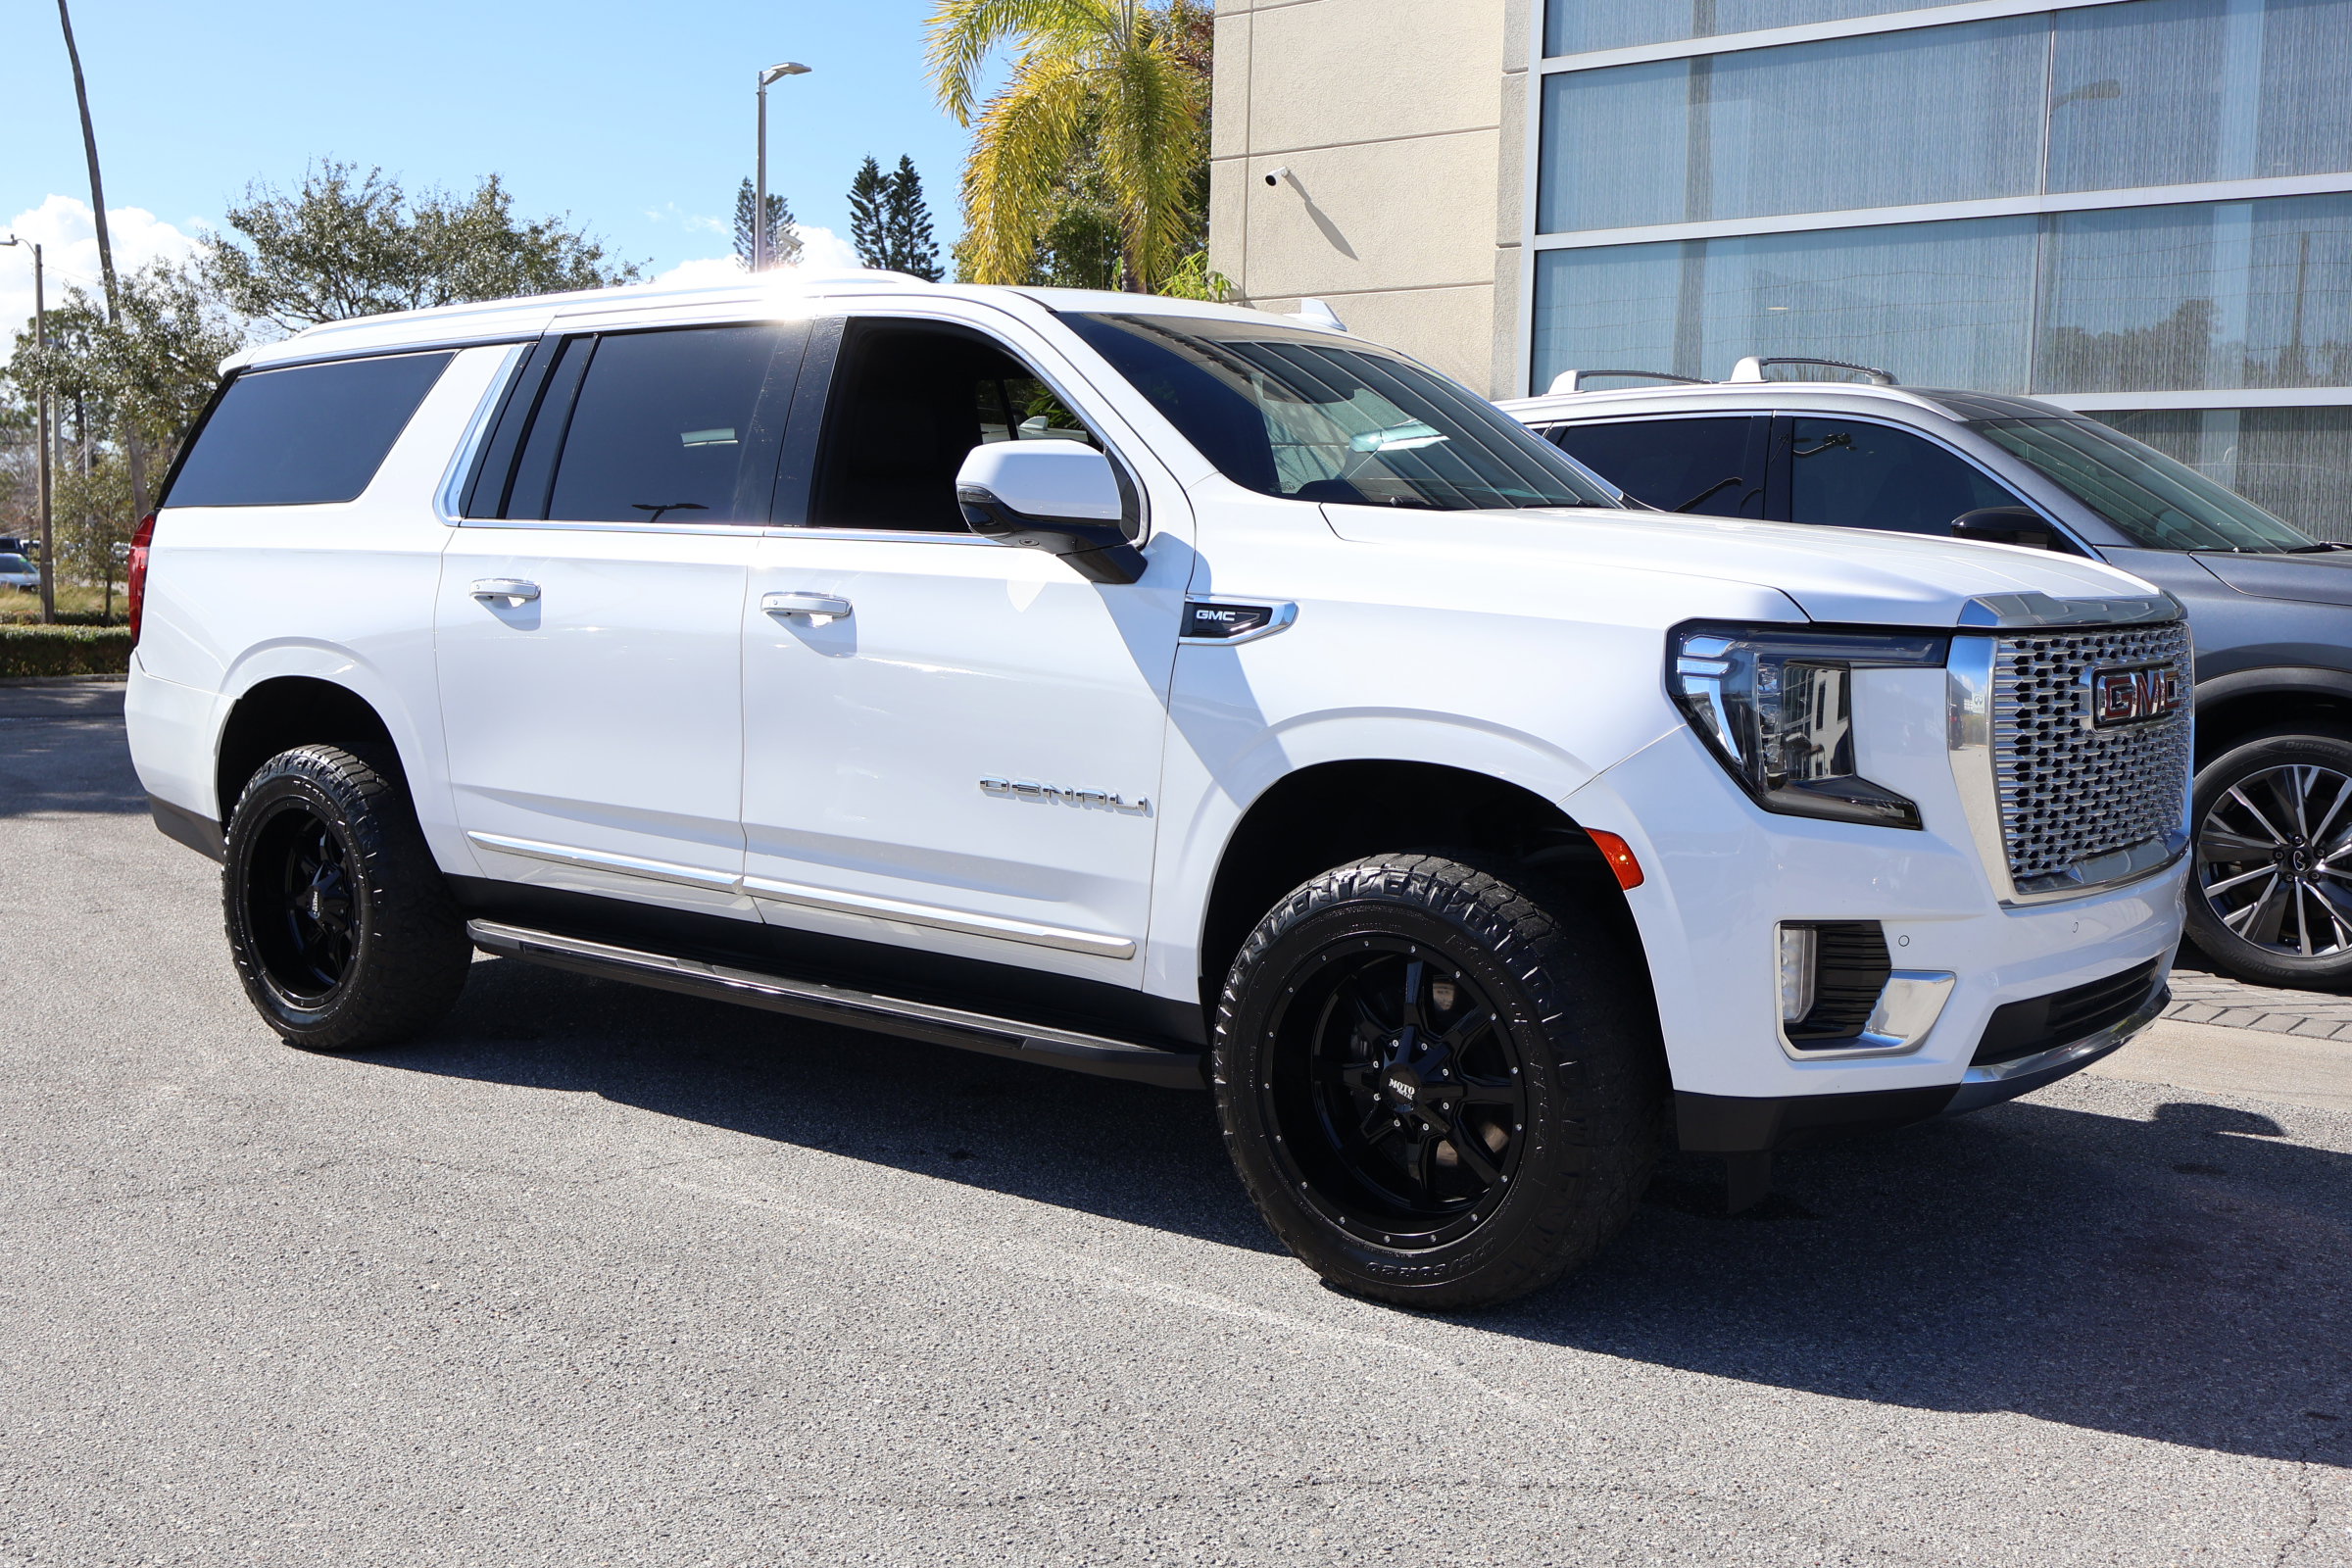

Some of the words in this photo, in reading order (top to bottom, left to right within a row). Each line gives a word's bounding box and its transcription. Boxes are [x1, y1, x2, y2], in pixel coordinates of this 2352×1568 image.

[1196, 609, 1236, 622] GMC
[2097, 667, 2181, 722] GMC
[979, 775, 1148, 812] DENALI
[1388, 1077, 1415, 1096] MOTO
